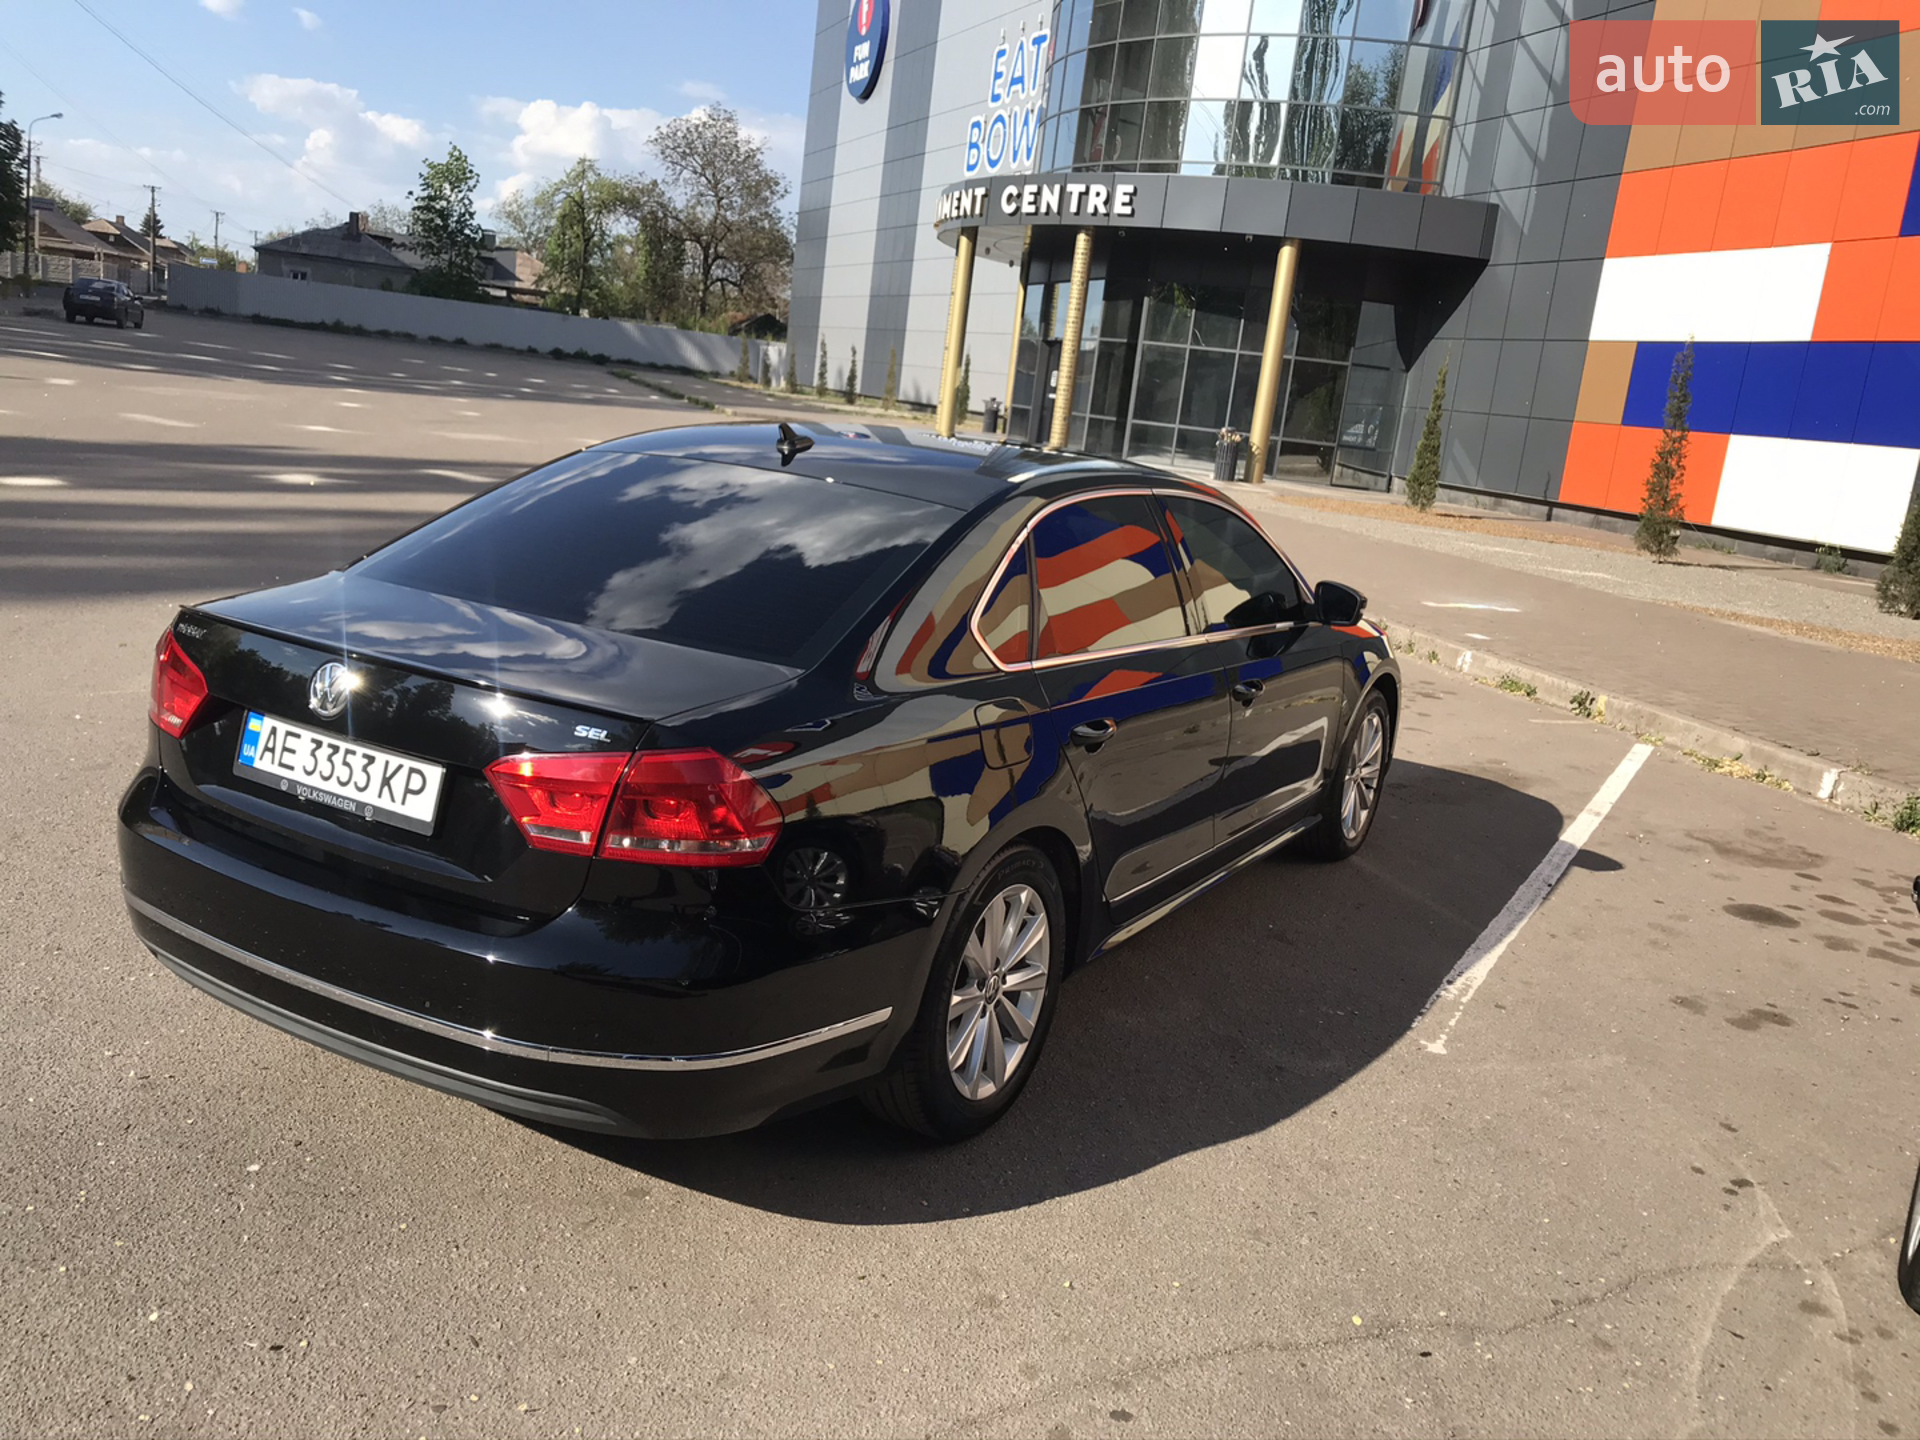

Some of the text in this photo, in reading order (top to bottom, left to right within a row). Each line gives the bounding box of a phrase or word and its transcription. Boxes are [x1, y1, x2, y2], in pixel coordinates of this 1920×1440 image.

[853, 40, 870, 63] FUN
[988, 29, 1050, 107] EAT
[935, 183, 1135, 222] MENT CENTRE
[574, 725, 611, 743] SEL
[243, 744, 255, 758] UA
[259, 726, 427, 806] AE 3353 KP
[296, 784, 356, 812] VOLKSWAGEN
